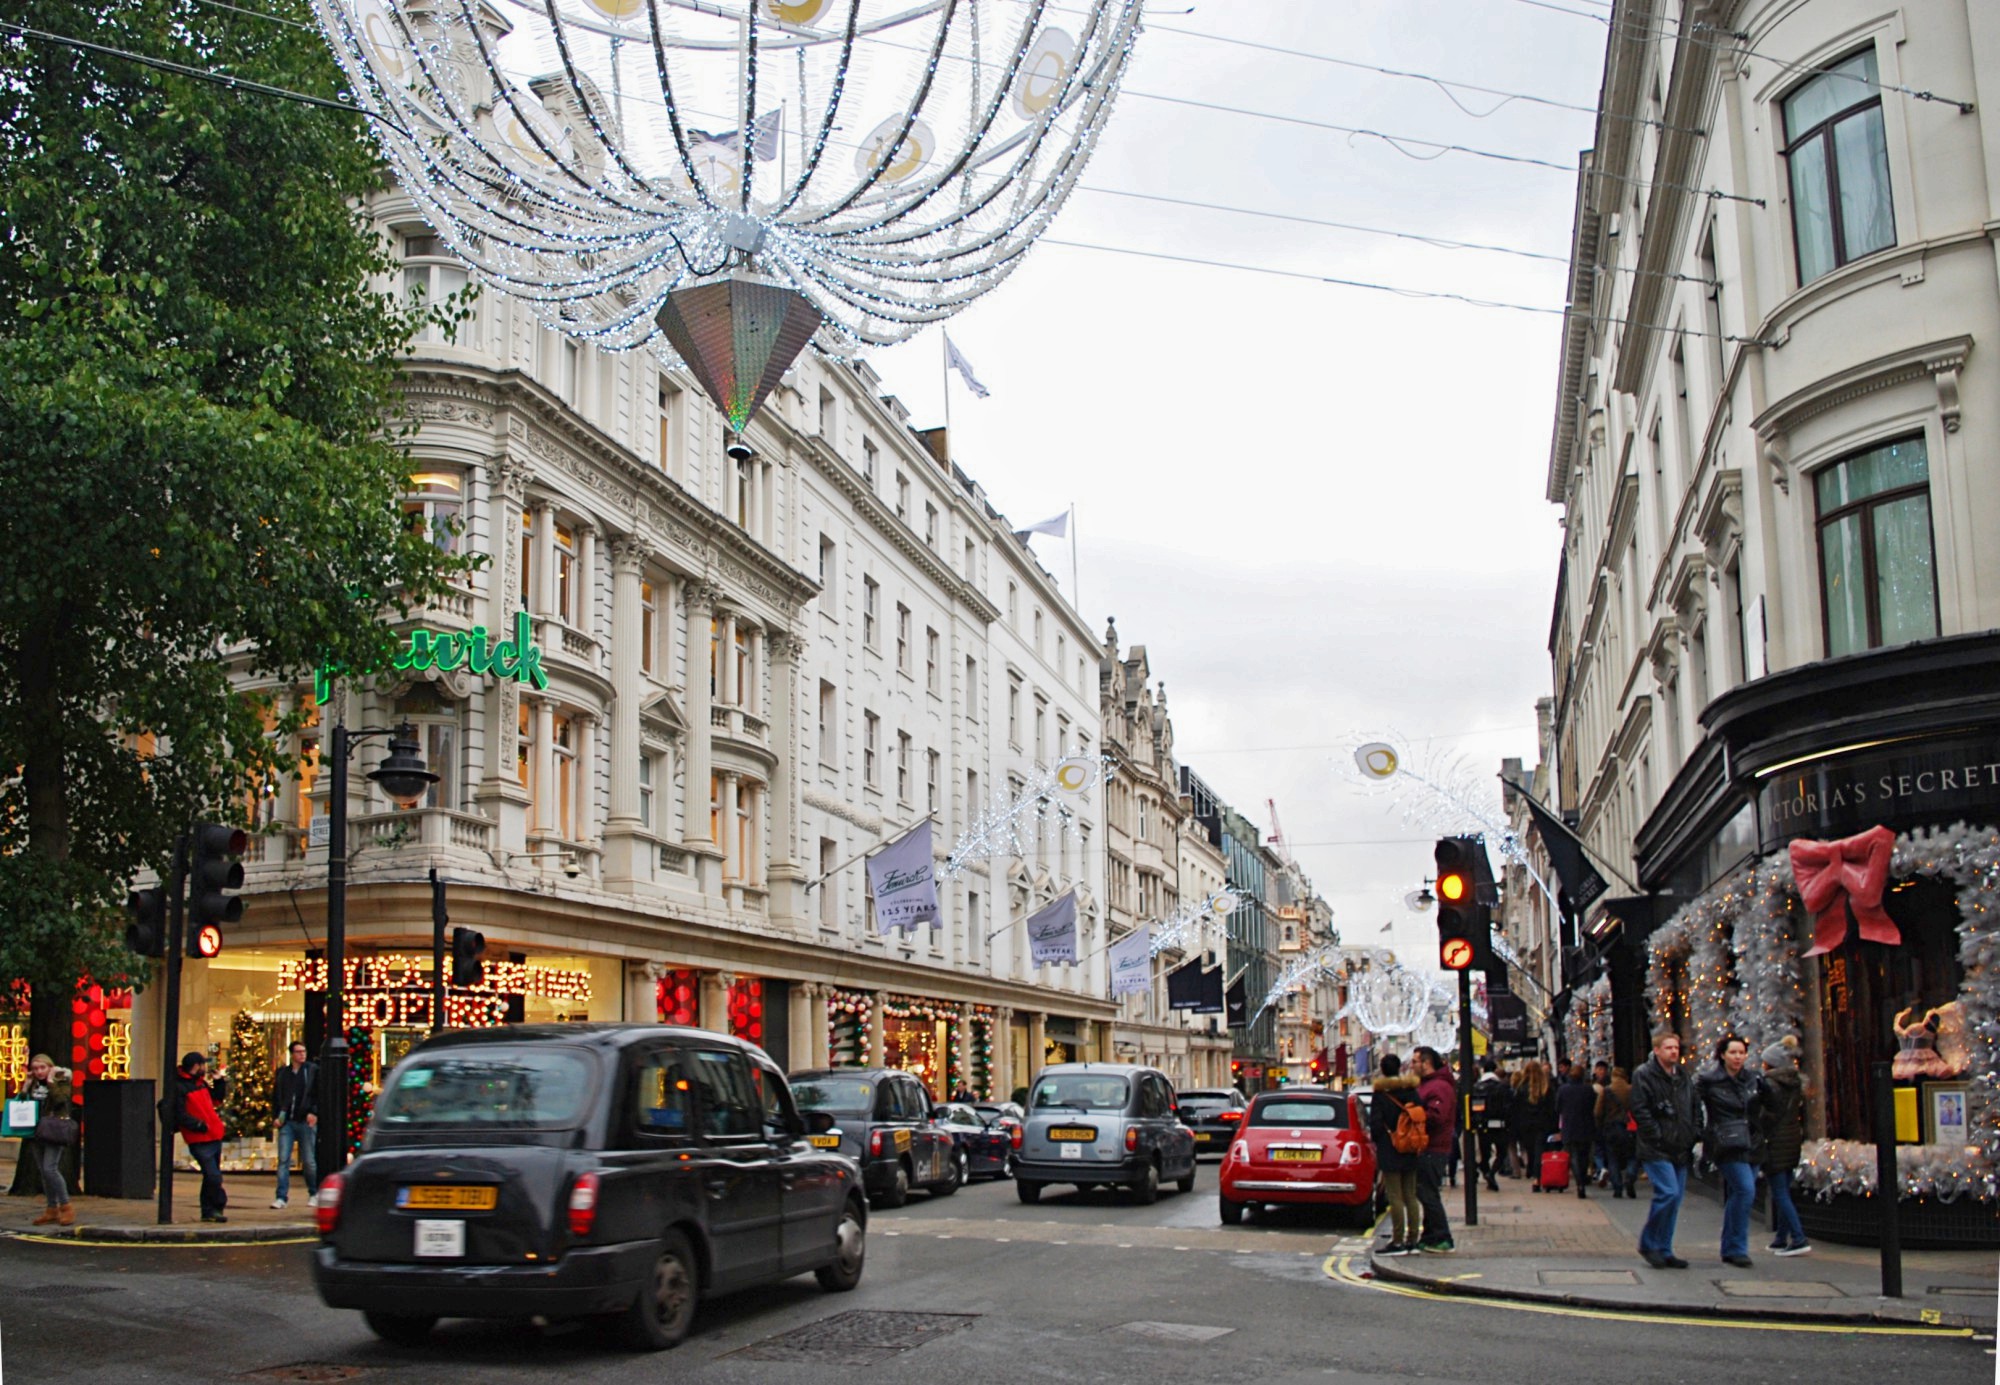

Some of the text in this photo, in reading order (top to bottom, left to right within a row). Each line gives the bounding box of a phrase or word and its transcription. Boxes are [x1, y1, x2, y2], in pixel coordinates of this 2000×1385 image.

[1879, 763, 2000, 800] SECRET
[312, 826, 330, 836] STREE
[882, 903, 937, 916] 125 YEARS
